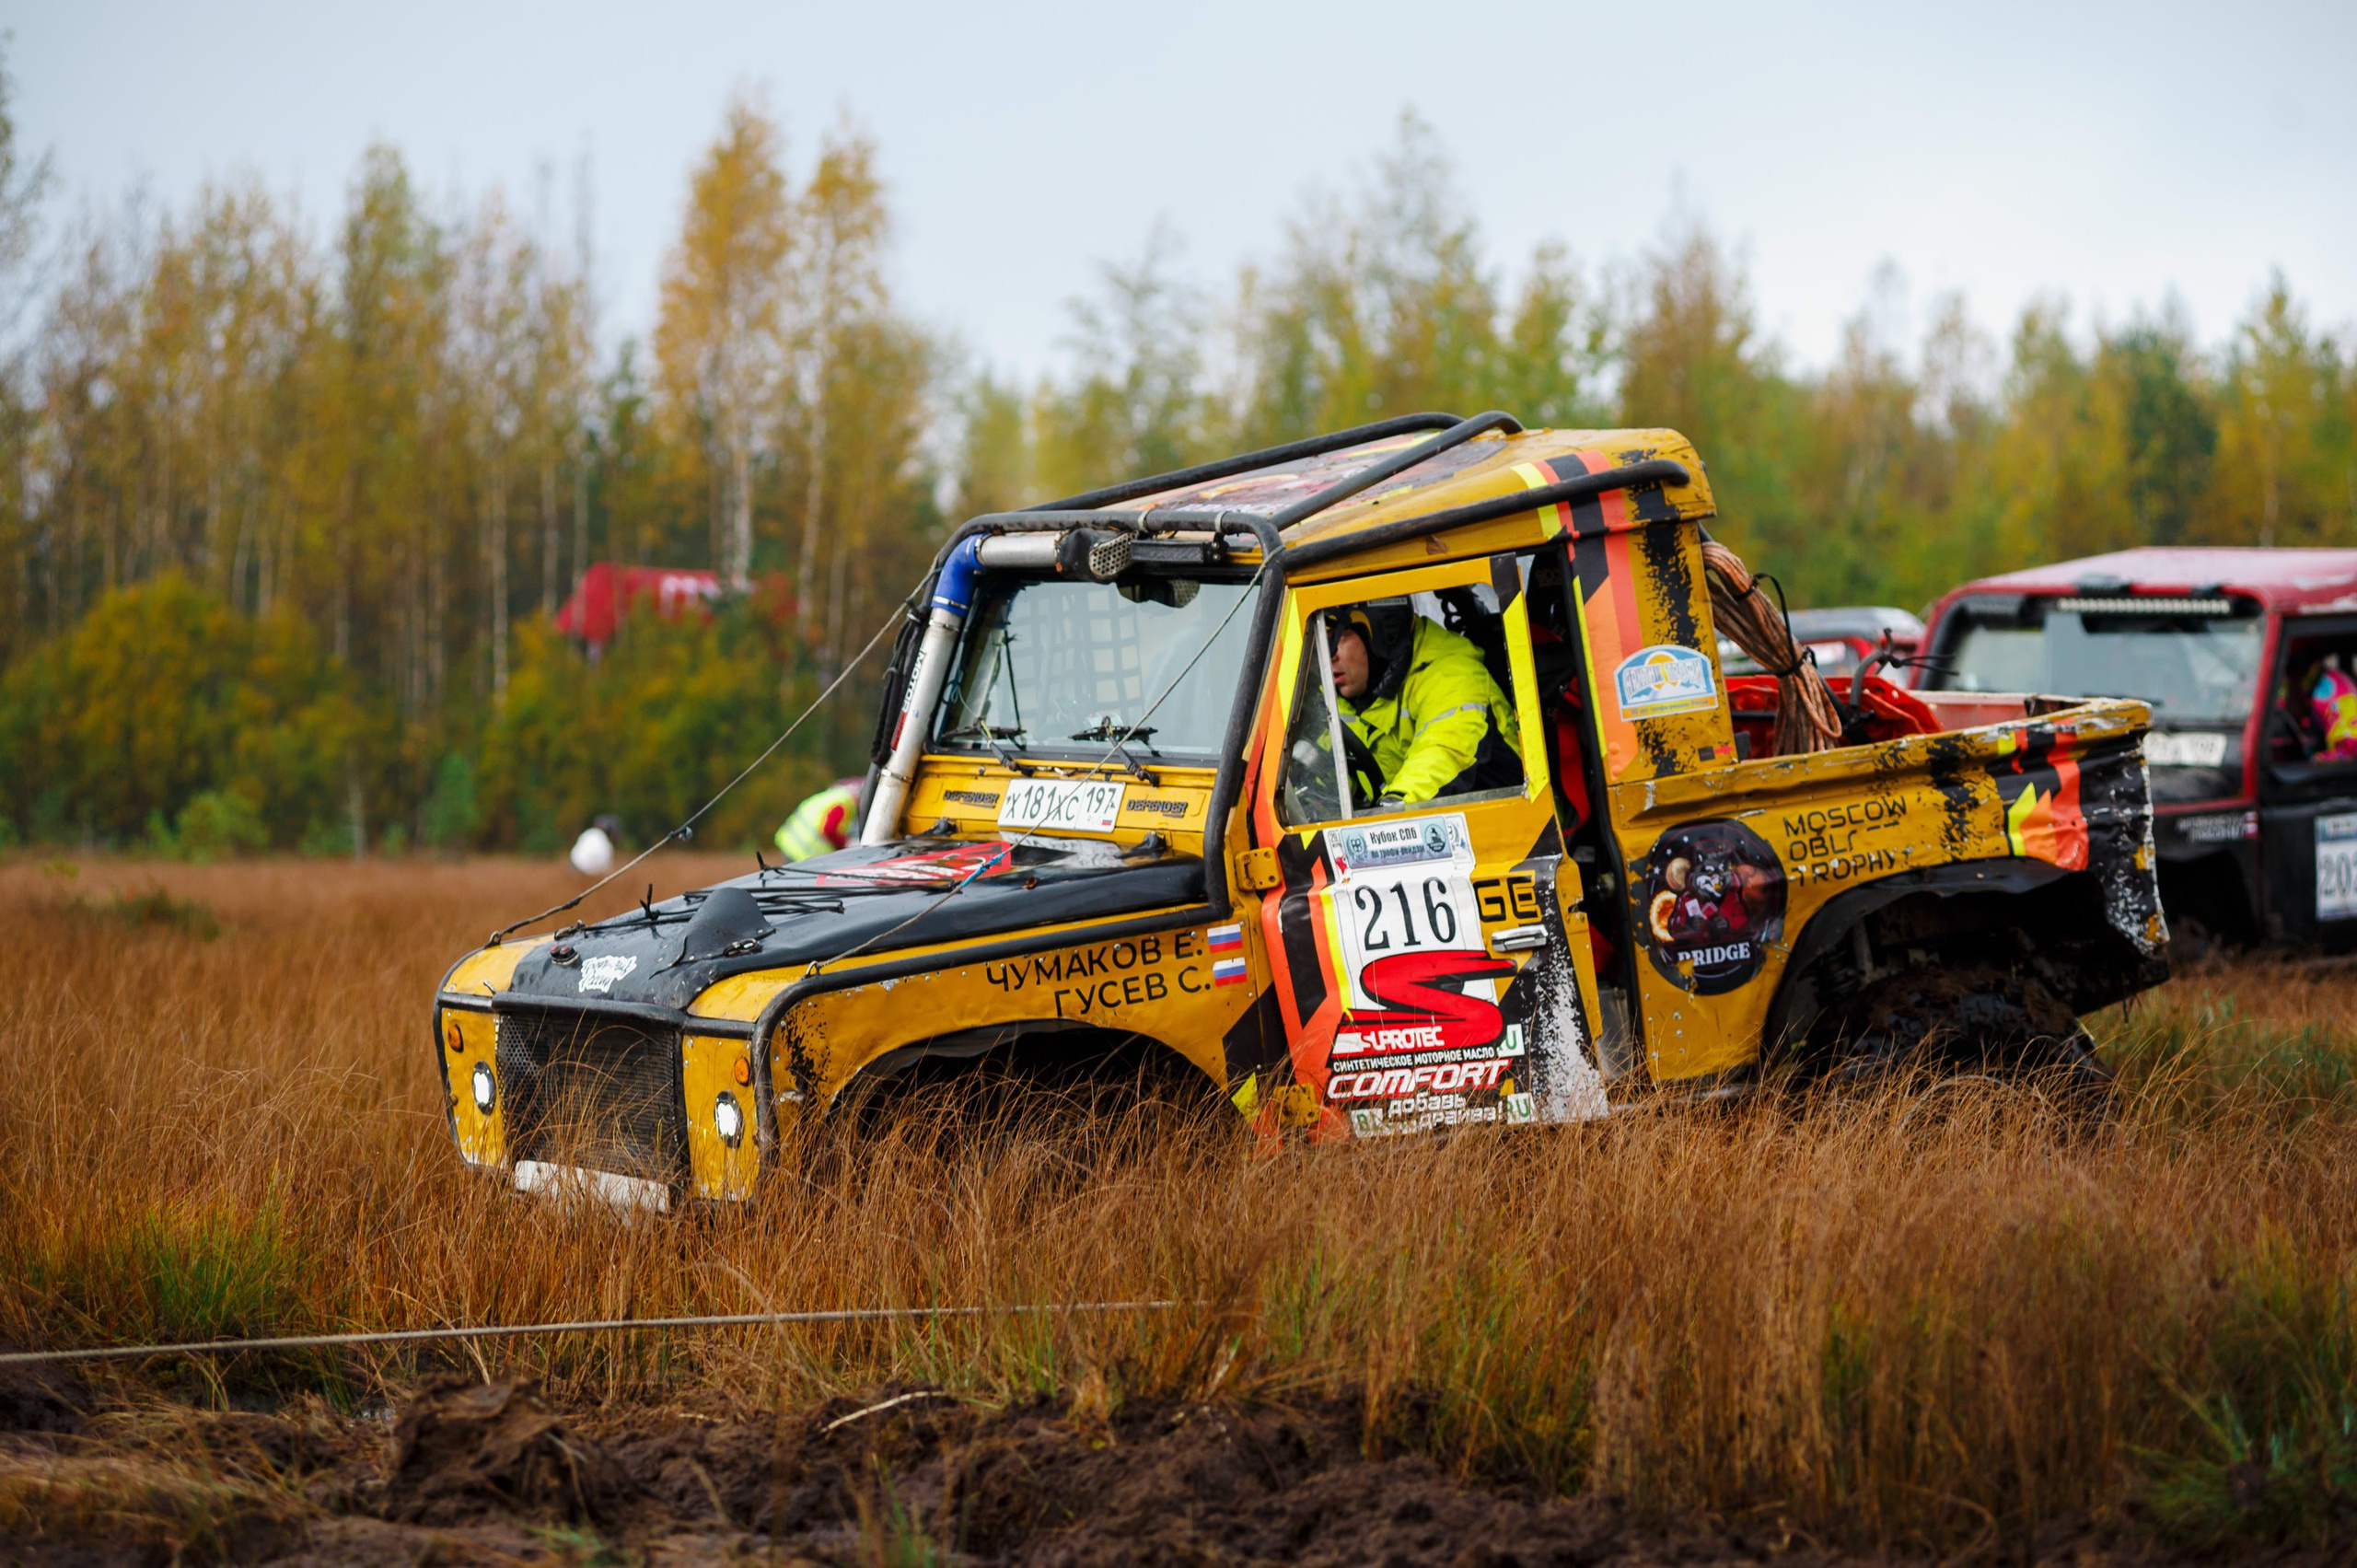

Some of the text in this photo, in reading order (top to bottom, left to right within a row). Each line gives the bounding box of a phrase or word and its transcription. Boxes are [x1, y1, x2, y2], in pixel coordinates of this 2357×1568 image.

[943, 789, 1000, 804] DEFENDER
[1086, 785, 1117, 814] 197
[1126, 798, 1188, 814] DEFENDER
[1783, 796, 1907, 837] MOSCOW
[1369, 830, 1399, 845] Кубок
[1789, 848, 1898, 887] TROPHY
[1354, 876, 1457, 951] 216
[986, 938, 1162, 992] ЧУМАКОВ
[1053, 972, 1168, 1016] ГУСЕВ
[1362, 1026, 1445, 1051] SUPROTEC
[1333, 1047, 1495, 1074] СИНТЕТИЧЕСКОЕ МОТОРНОЕ МАСЛО
[1327, 1059, 1510, 1099] COMFORT
[1387, 1092, 1467, 1118] добавь
